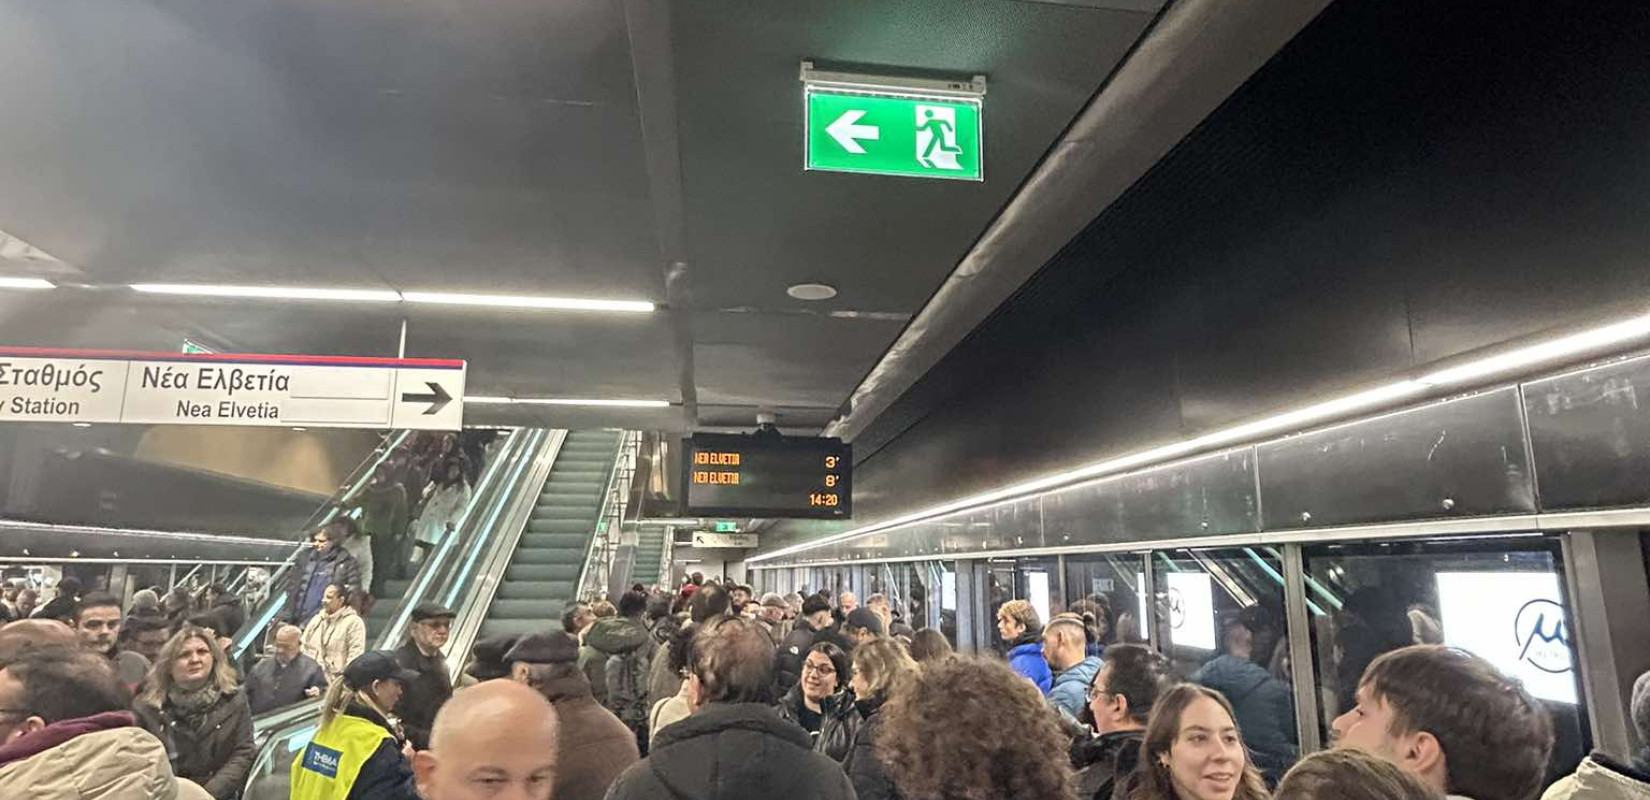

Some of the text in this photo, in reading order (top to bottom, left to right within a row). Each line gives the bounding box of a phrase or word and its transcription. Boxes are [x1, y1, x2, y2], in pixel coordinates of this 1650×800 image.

[0, 363, 103, 393] Σταθμός
[142, 366, 290, 396] Νέα Ελβετία
[11, 396, 80, 415] Station
[176, 400, 279, 419] Nea Elvetia
[694, 452, 709, 464] NEA
[710, 452, 740, 465] ELVETIA
[693, 471, 708, 484] NEA
[709, 471, 739, 485] ELVETIA
[809, 493, 838, 506] 14:20
